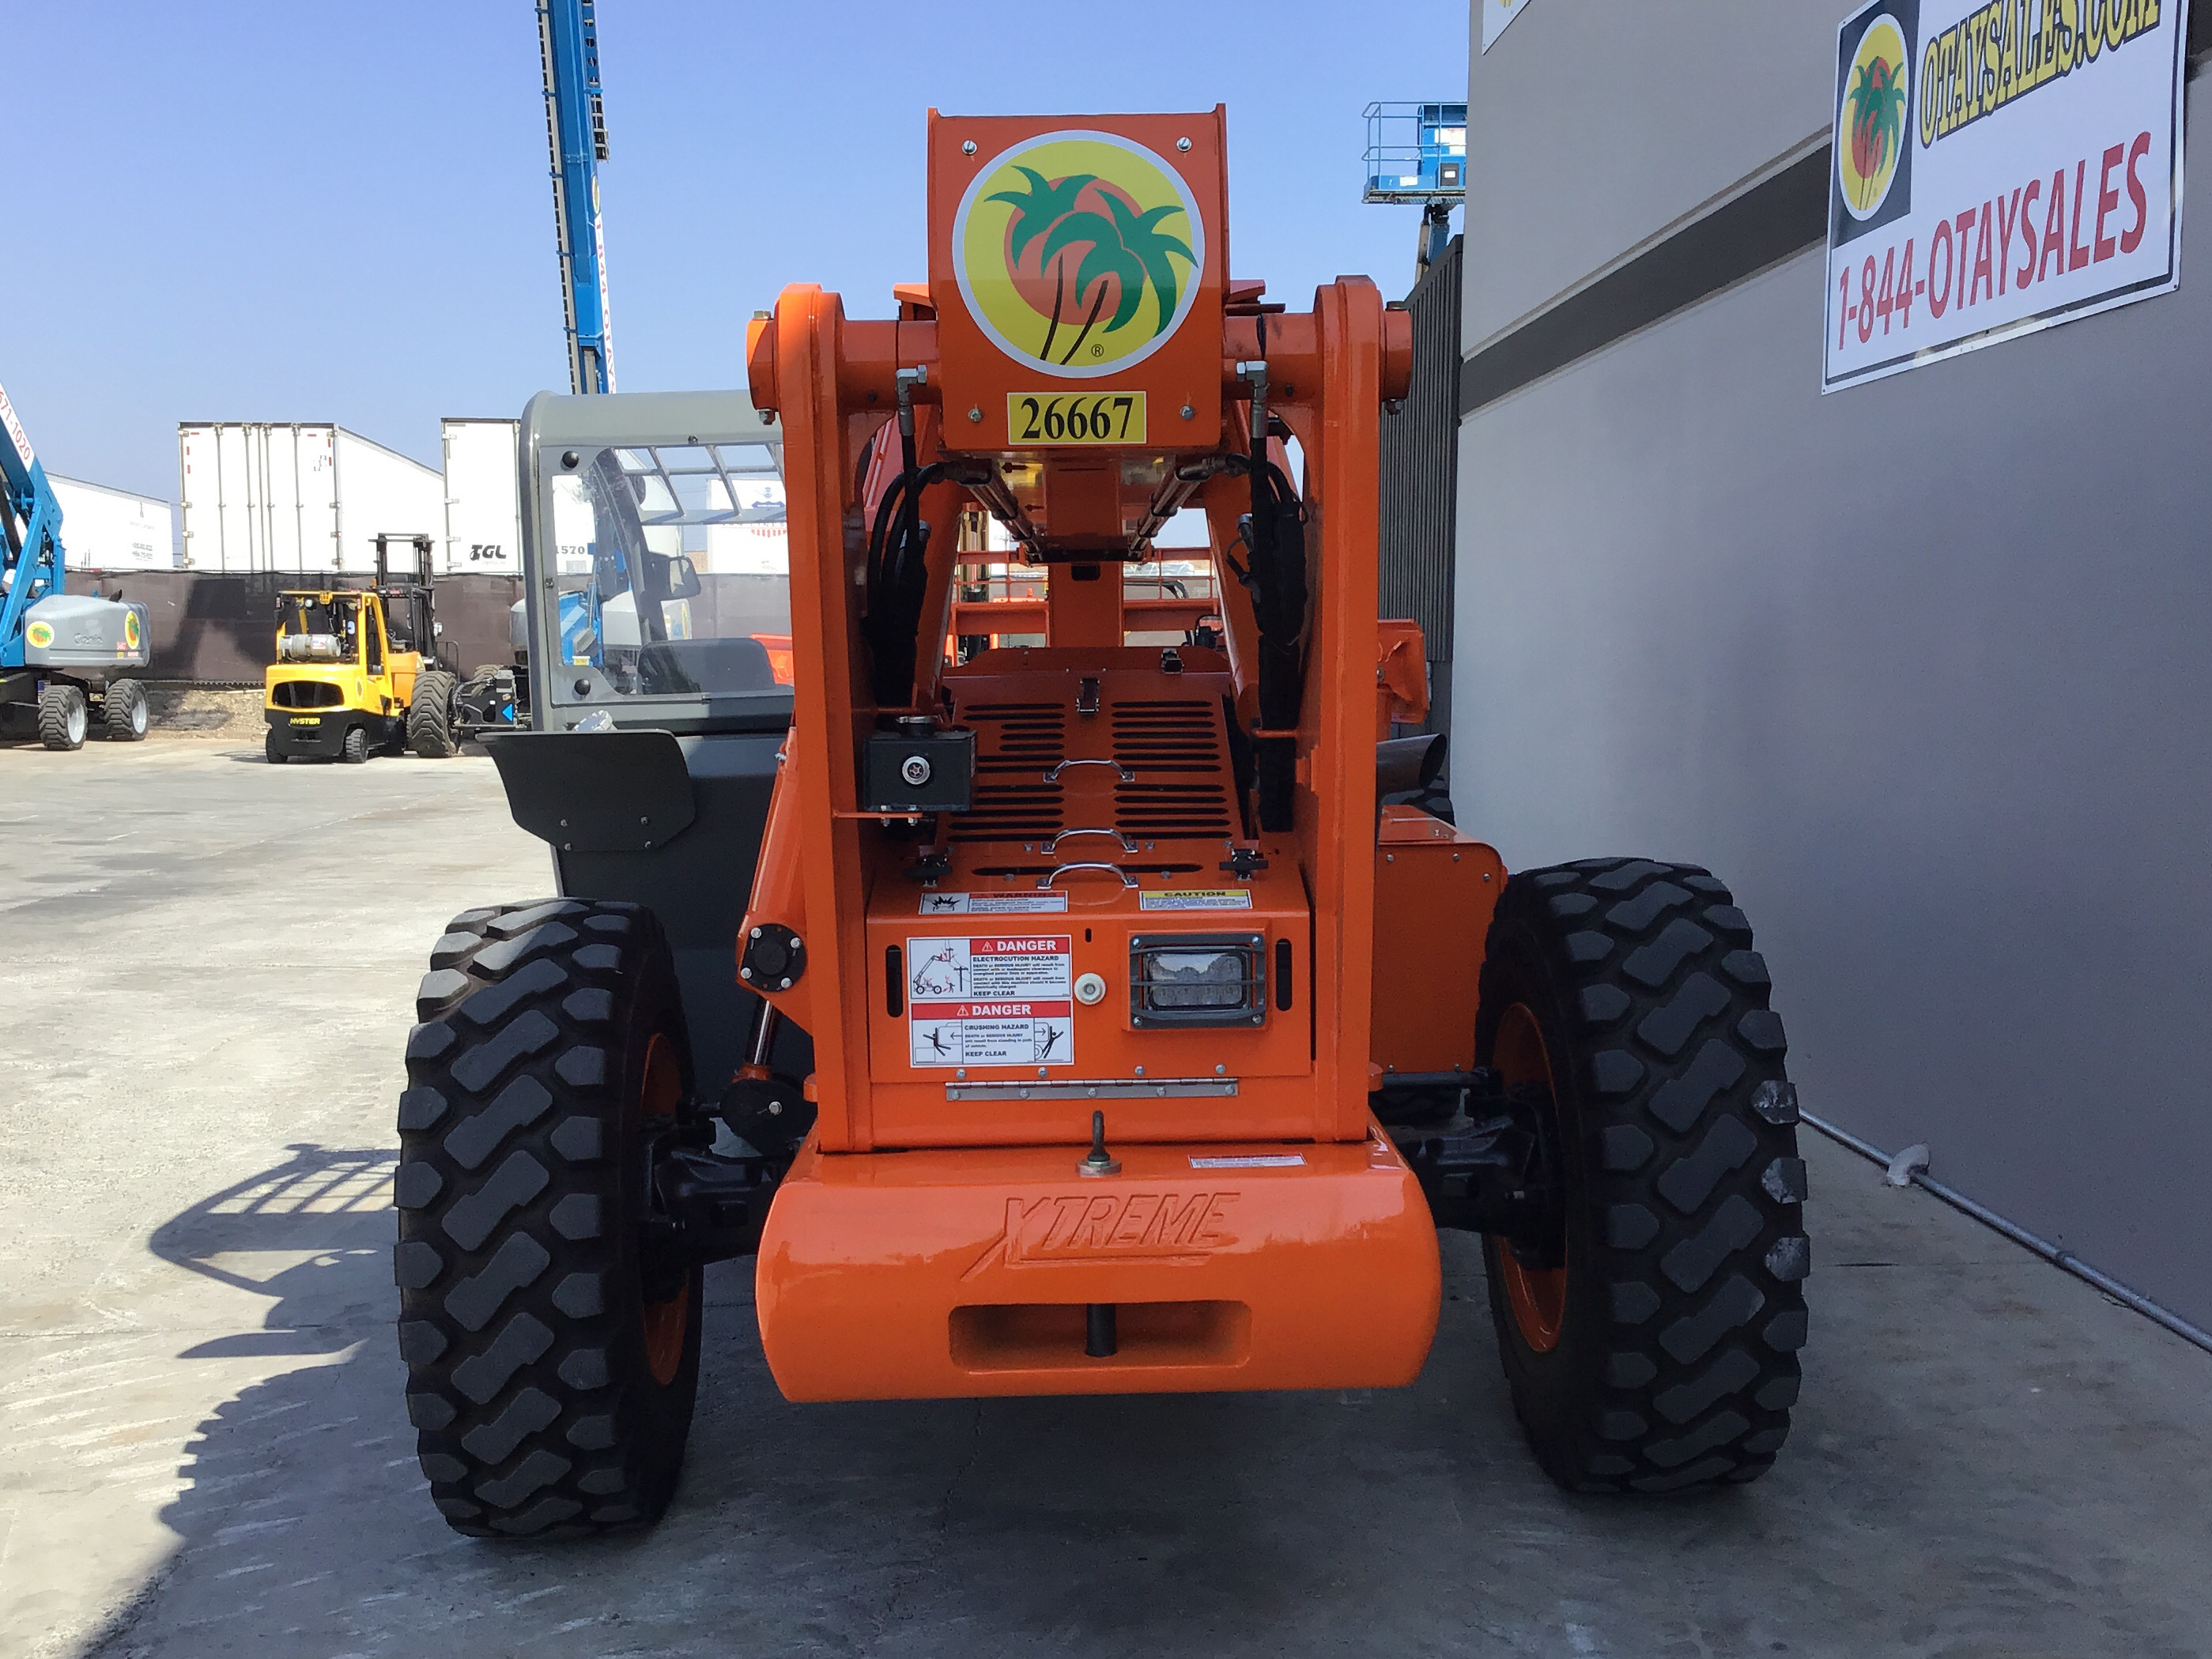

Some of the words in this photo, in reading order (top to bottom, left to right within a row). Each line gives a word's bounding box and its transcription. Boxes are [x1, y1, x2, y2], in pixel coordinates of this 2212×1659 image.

[1839, 131, 2150, 350] 1-844-OTAYSALES
[1021, 397, 1134, 439] 26667
[997, 941, 1056, 951] DANGER
[972, 1005, 1031, 1016] DANGER
[960, 1193, 1240, 1281] XTREME
